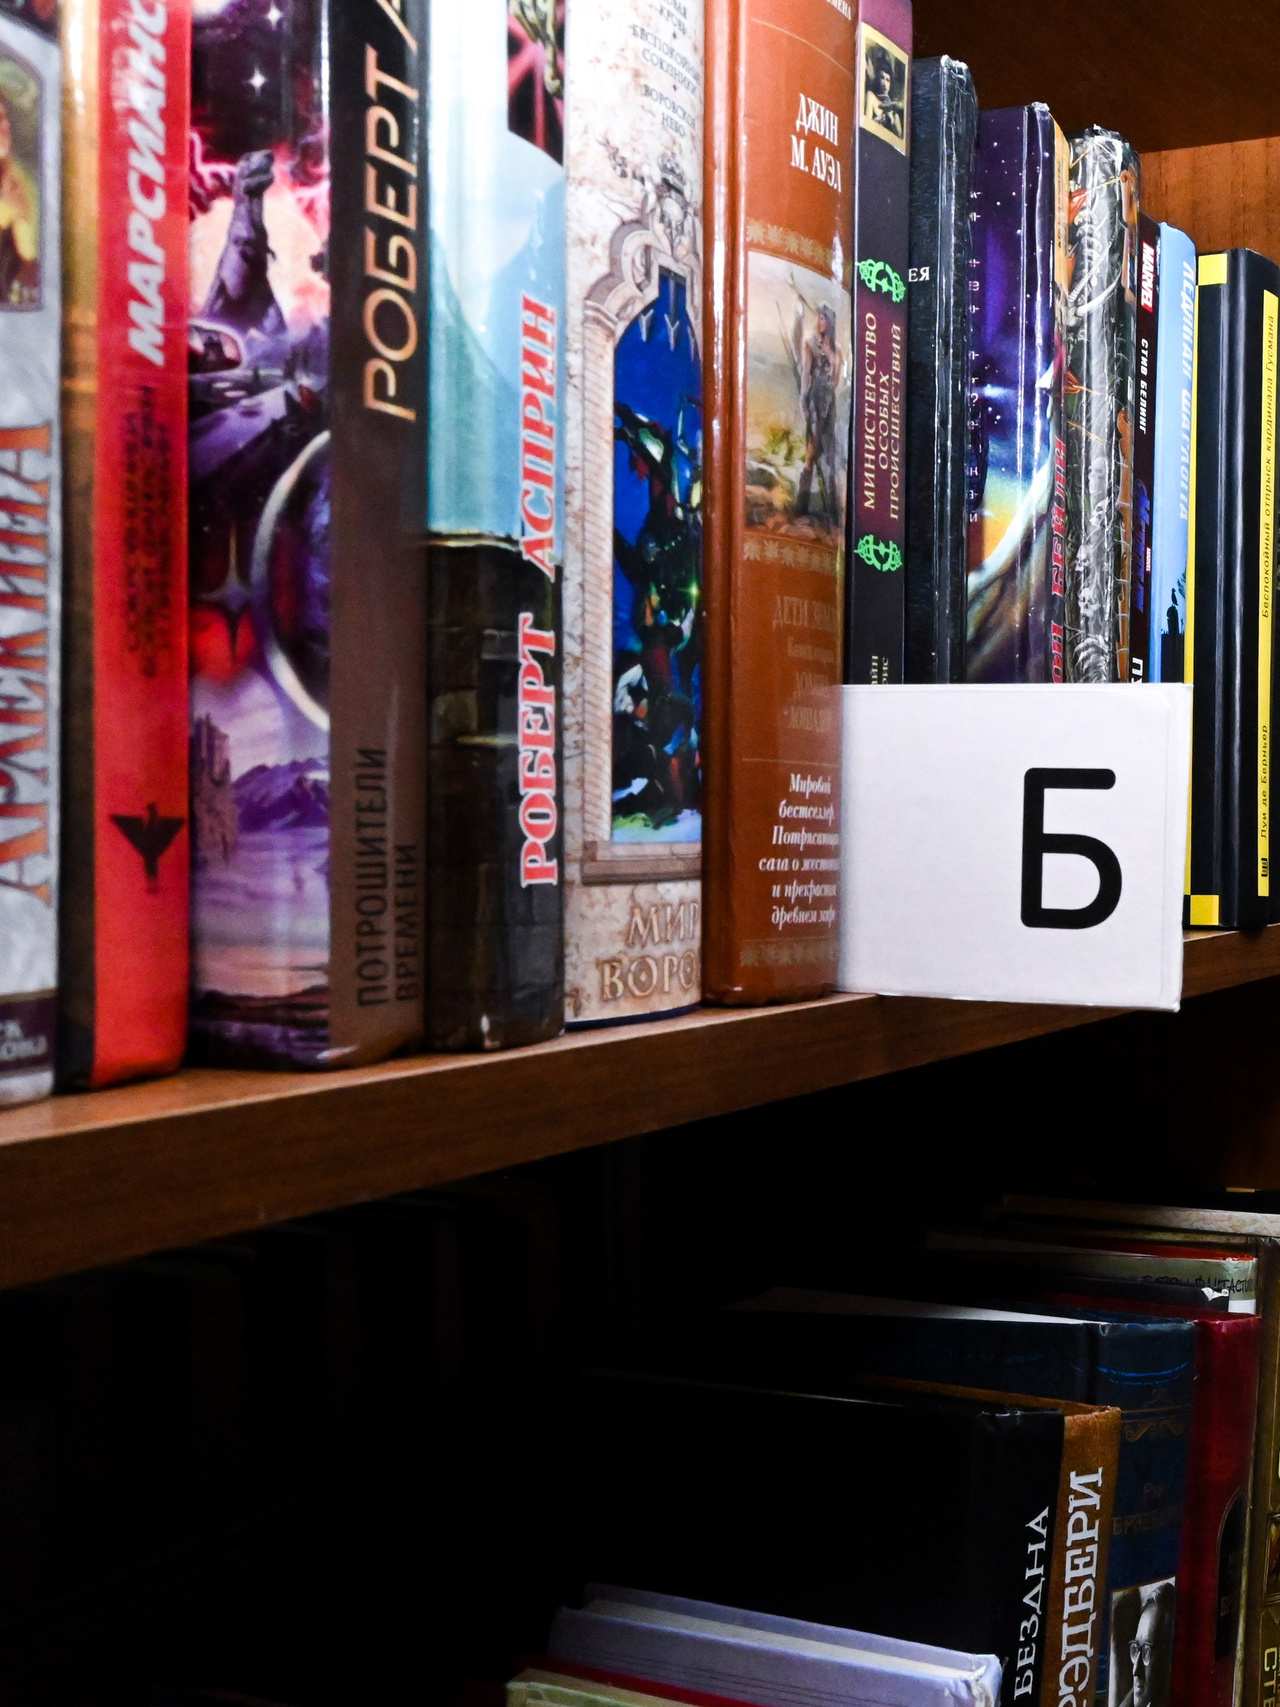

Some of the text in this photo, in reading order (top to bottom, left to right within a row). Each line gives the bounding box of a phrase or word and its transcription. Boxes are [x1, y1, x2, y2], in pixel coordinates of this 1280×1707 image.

[796, 93, 839, 146] ДЖИН
[364, 43, 420, 422] РОБЕРТ
[1141, 241, 1154, 313] MARVEL
[863, 312, 878, 510] МИНИСТЕРСТВО
[879, 373, 891, 471] ОСОБЫХ
[889, 323, 902, 521] ПРОИСШЕСТВИЙ
[1139, 338, 1148, 434] СТИВ БЕЛИНГ
[1261, 315, 1275, 619] Беспокойный отпрыск кардинала Гусмана
[518, 294, 561, 889] РОБЕРТ АСПРИН
[788, 772, 832, 799] Мировой
[1261, 724, 1270, 785] Берньер
[356, 746, 389, 1008] ПОТРОШИТЕЛИ
[758, 857, 789, 872] сага
[1021, 768, 1121, 931] Б
[393, 843, 419, 1003] ВРЕМЕНИ
[601, 950, 700, 1001] ВОРО
[771, 906, 817, 930] древнем
[1013, 1506, 1050, 1701] БЕЗДНА
